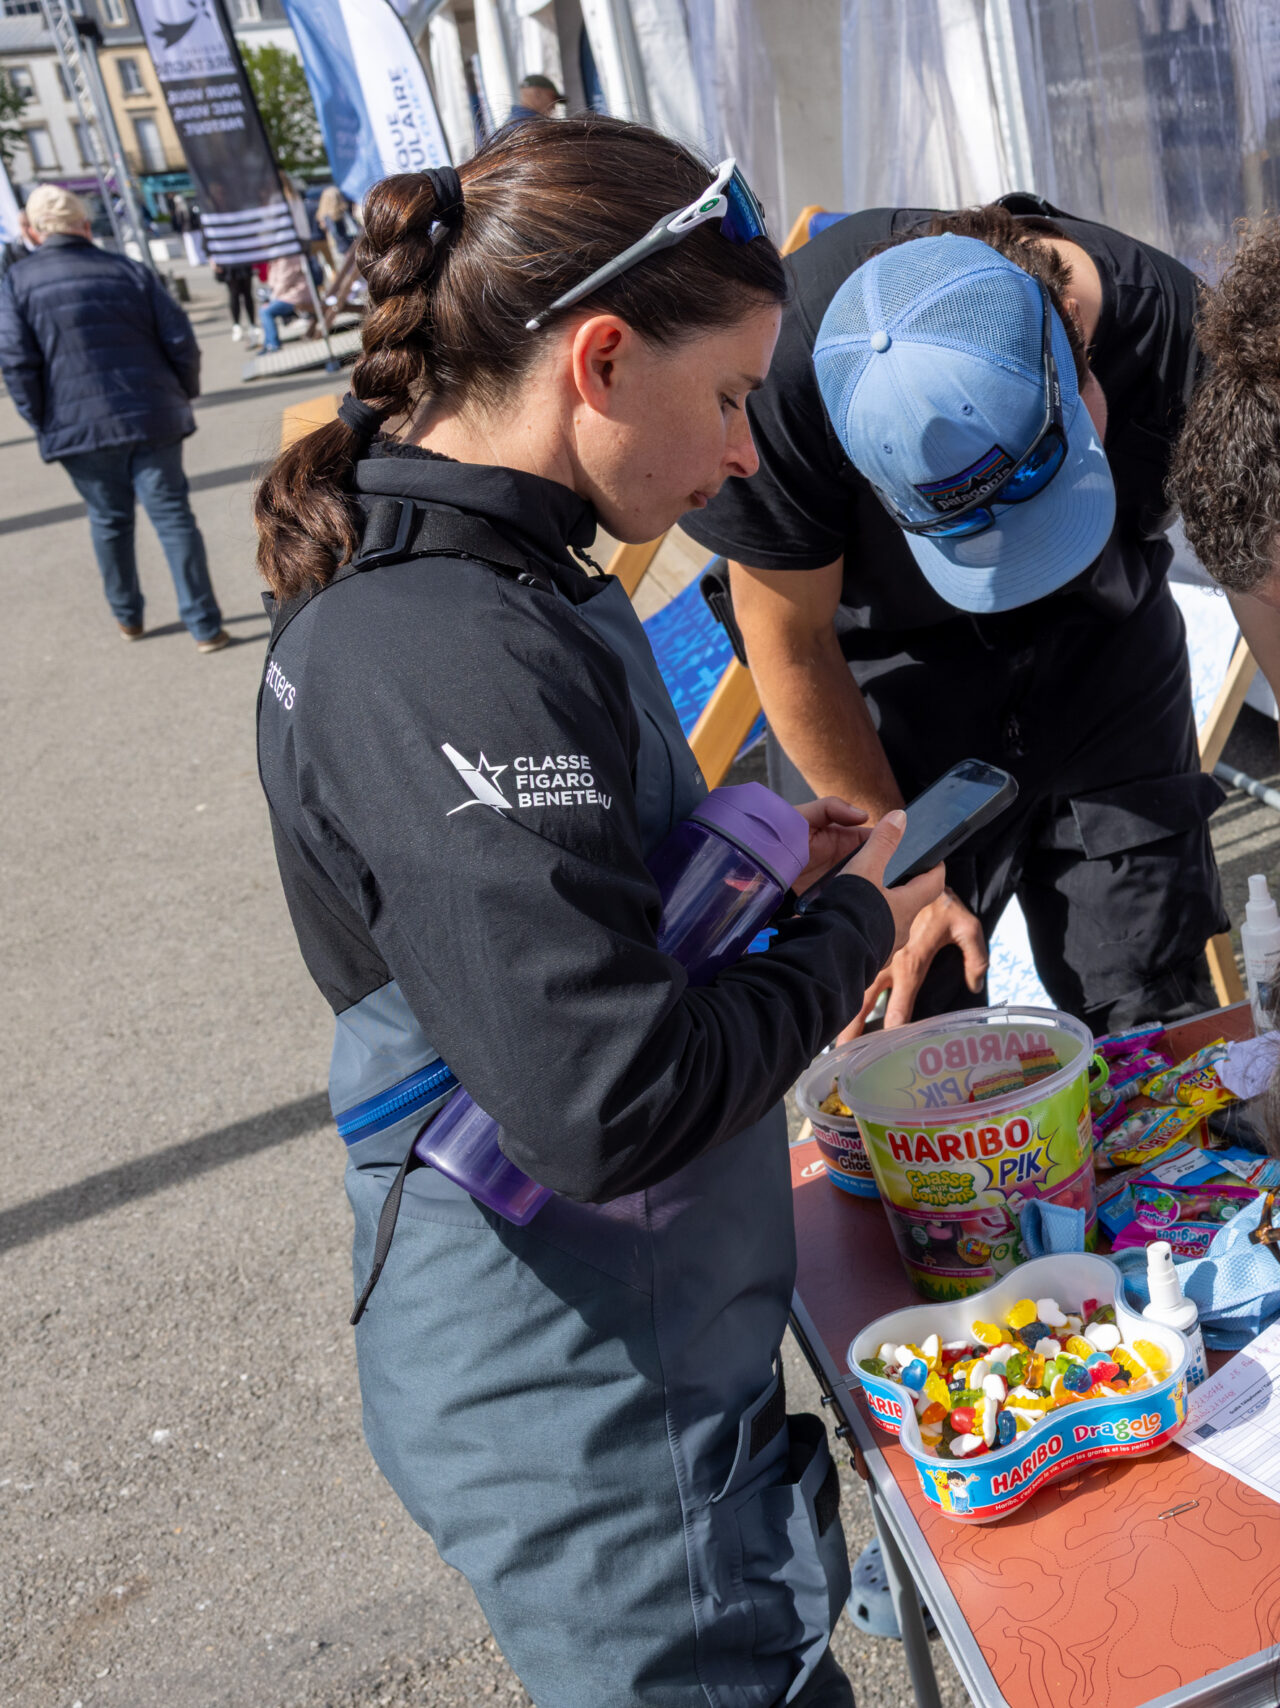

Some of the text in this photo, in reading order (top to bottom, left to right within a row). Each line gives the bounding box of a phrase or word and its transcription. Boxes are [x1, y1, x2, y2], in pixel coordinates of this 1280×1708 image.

[513, 755, 592, 772] CLASSE
[515, 773, 595, 790] FIGARO
[886, 1117, 1032, 1164] HARIBO
[905, 1169, 975, 1188] Chasse
[930, 1184, 949, 1192] aux
[911, 1186, 978, 1206] bonbons
[1156, 1227, 1211, 1247] Dragibus
[1076, 1453, 1086, 1461] les
[1087, 1446, 1111, 1458] grands
[1119, 1444, 1130, 1452] les
[1131, 1440, 1150, 1452] petits
[991, 1434, 1063, 1496] HARIBO
